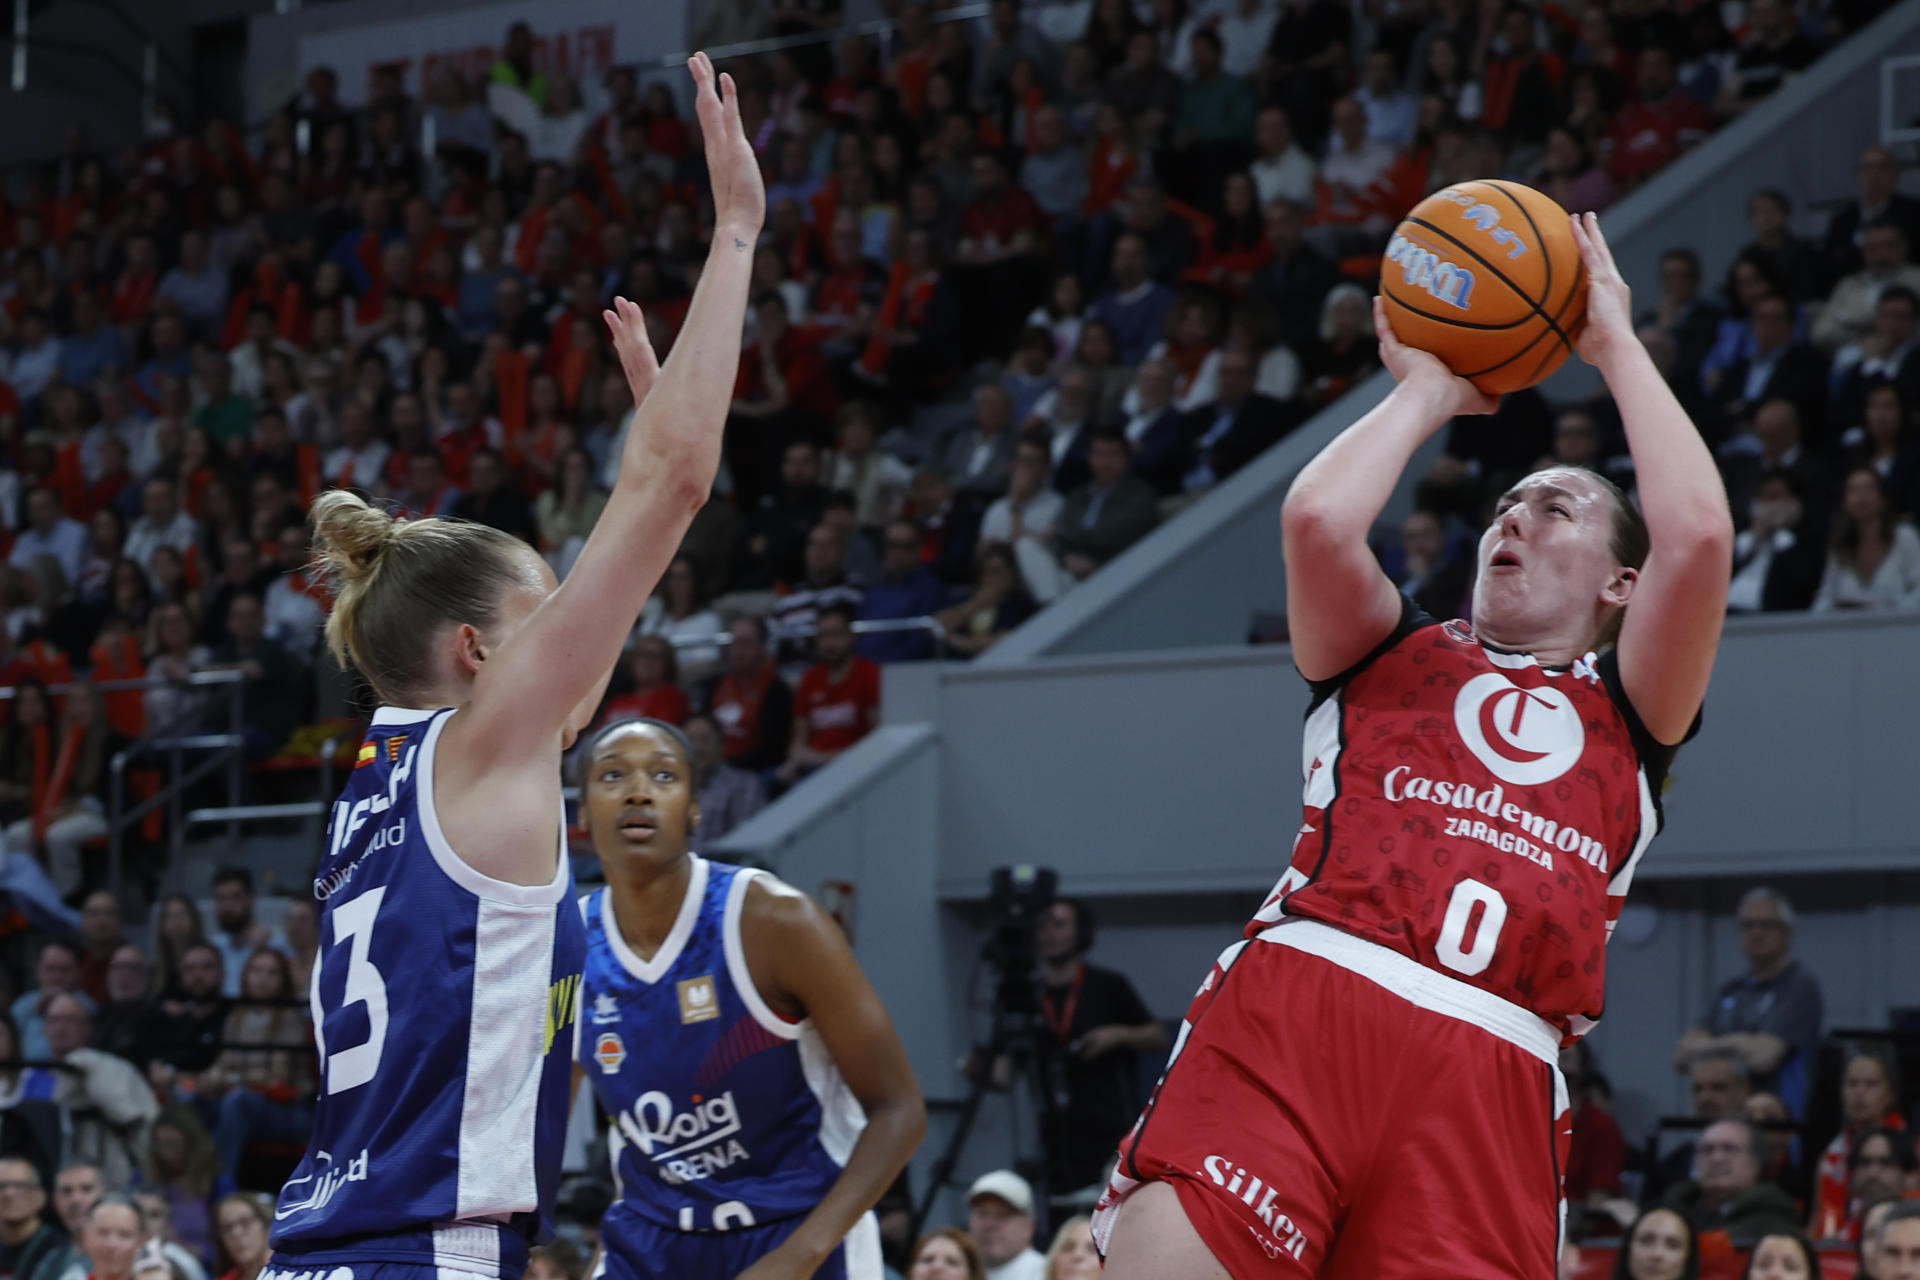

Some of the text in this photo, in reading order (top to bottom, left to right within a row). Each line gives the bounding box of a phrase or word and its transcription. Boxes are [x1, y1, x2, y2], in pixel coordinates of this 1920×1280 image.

[1386, 233, 1475, 310] Wilso
[1444, 817, 1554, 872] ZARAGOZA
[1434, 877, 1508, 977] 0
[619, 1090, 742, 1161] Roig
[1203, 1155, 1308, 1262] Silken
